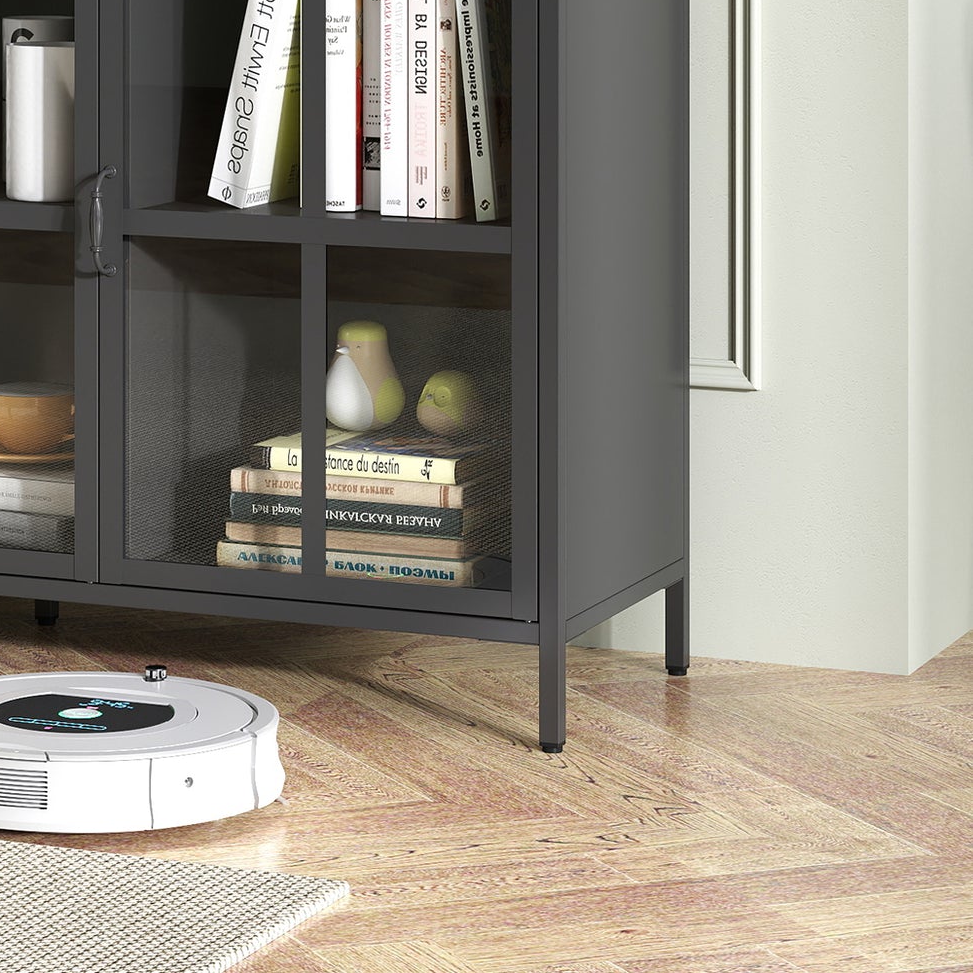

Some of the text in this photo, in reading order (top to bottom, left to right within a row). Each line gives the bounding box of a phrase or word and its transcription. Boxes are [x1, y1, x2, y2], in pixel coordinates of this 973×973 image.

[287, 448, 298, 466] La
[325, 455, 354, 472] stance
[356, 454, 369, 472] du
[372, 455, 400, 474] destin
[237, 552, 455, 581] АЛЕКСА БЛОК ПОЭМЫ
